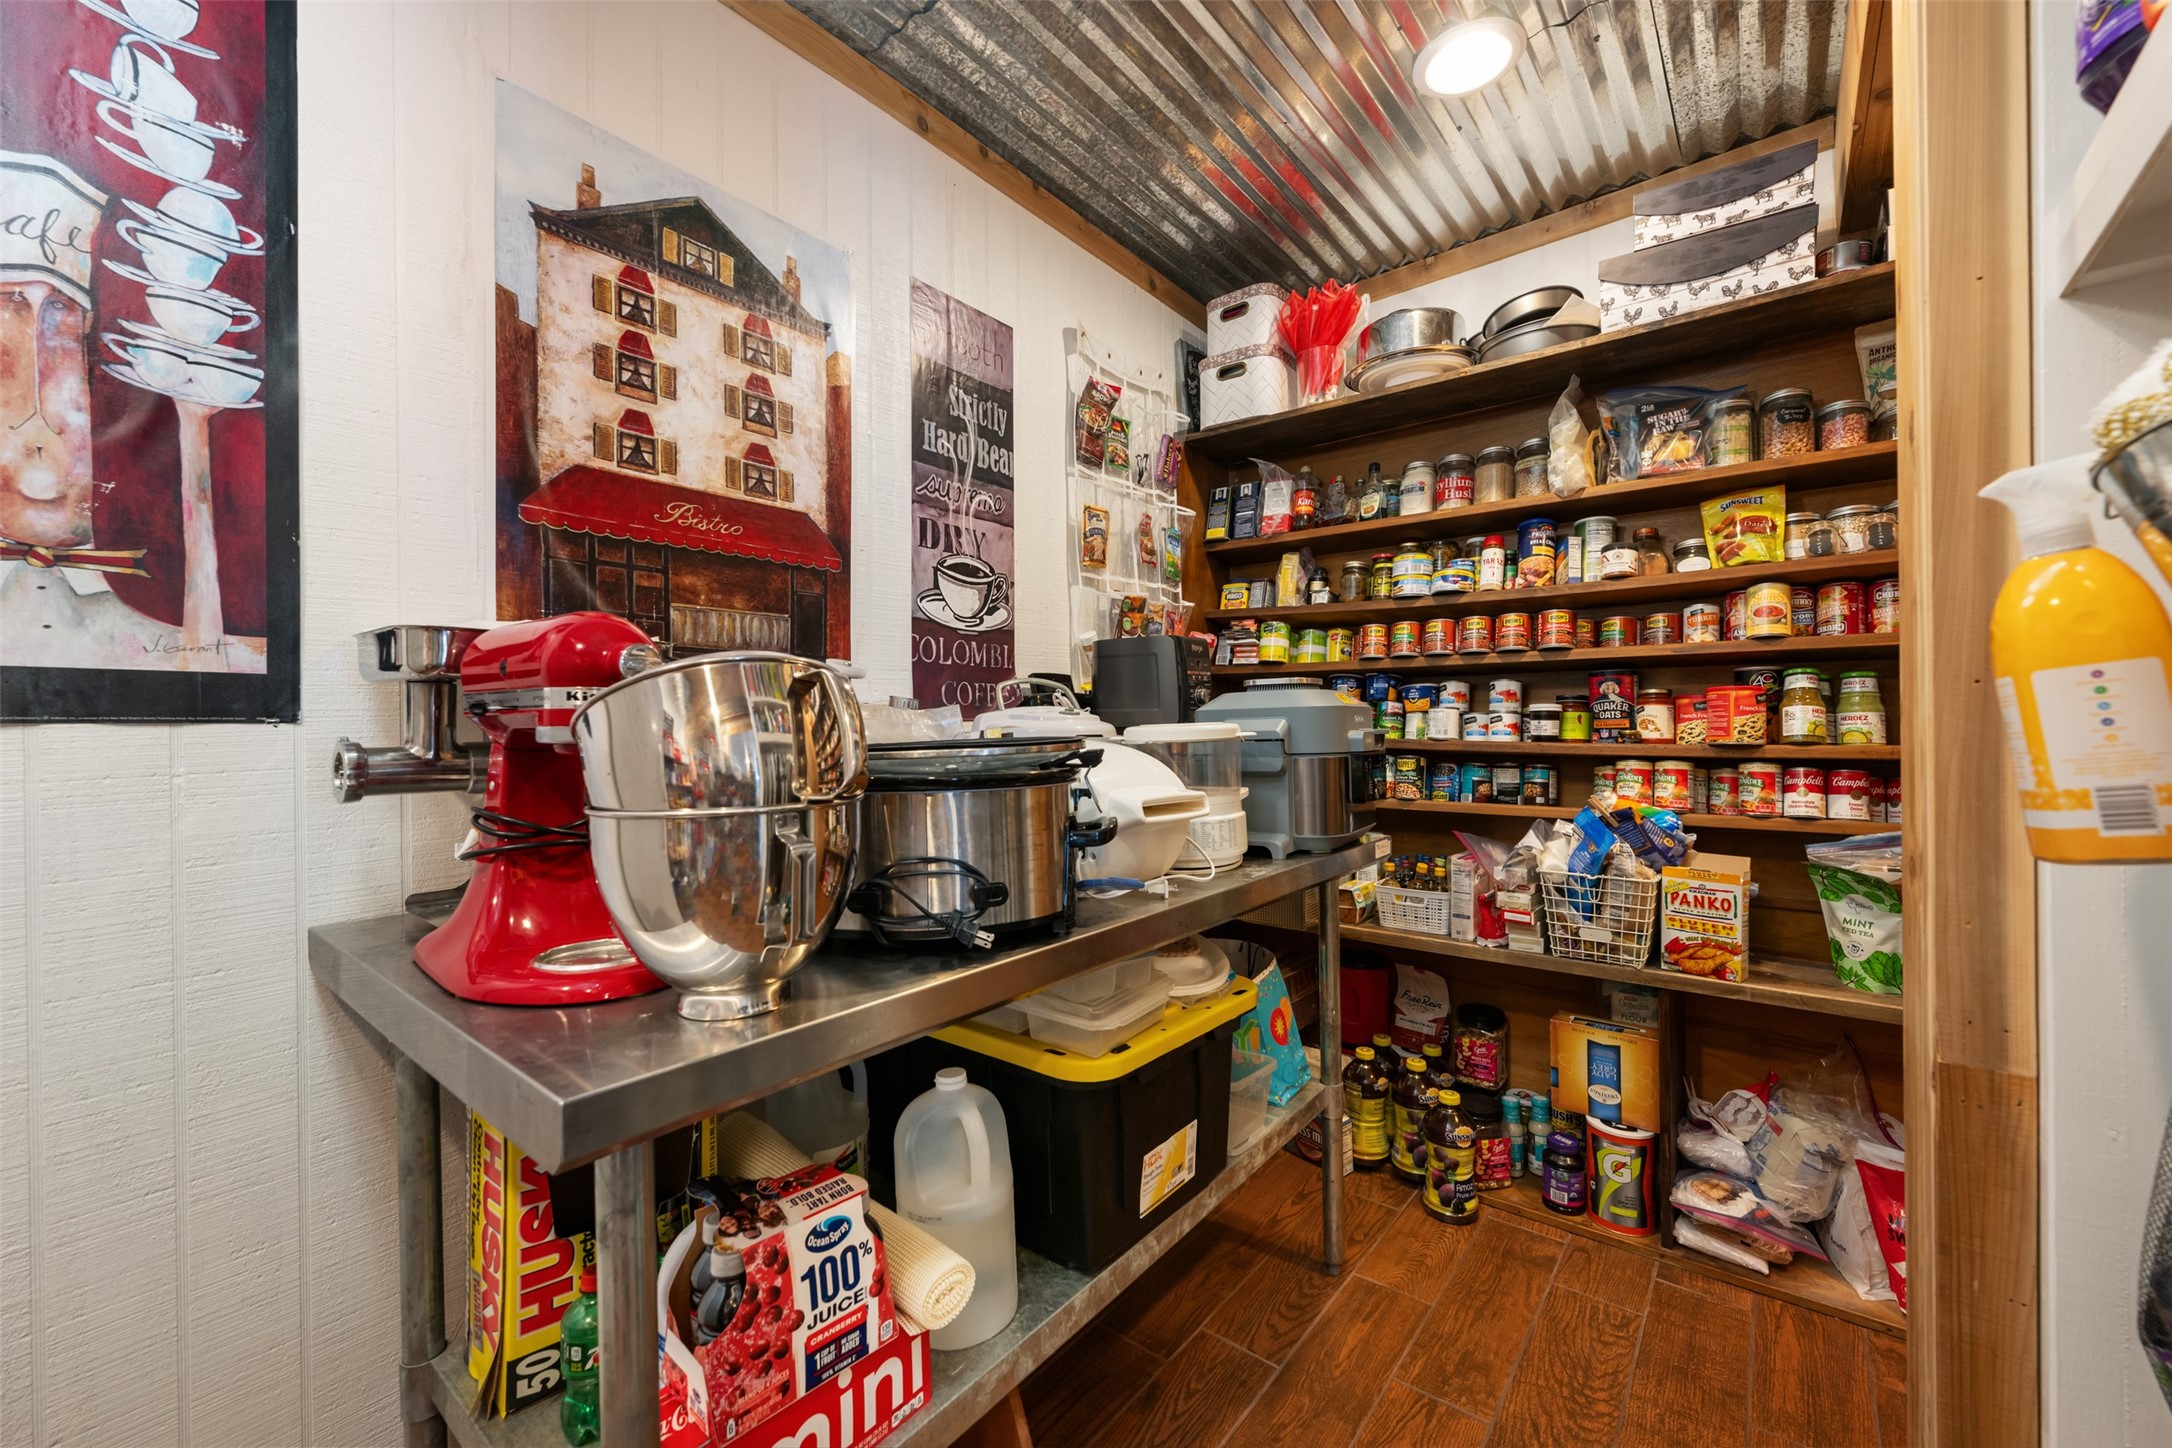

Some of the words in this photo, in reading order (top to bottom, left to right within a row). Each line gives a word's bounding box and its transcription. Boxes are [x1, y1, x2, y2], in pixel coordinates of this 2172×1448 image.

[0, 209, 92, 265] afe
[949, 383, 1007, 437] Strictly
[922, 418, 970, 464] Hard
[1444, 487, 1474, 500] Husk
[1720, 495, 1765, 513] SUNSWEET
[653, 501, 744, 536] Bistro
[1226, 592, 1243, 600] ARGO
[1688, 614, 1718, 624] TURKEY
[1593, 702, 1630, 713] QUAKER
[1599, 711, 1622, 719] OATS
[1670, 890, 1732, 912] PANKO
[1669, 916, 1734, 931] GLUTEN
[1842, 917, 1875, 929] MINT
[1858, 929, 1874, 939] TEA
[1400, 989, 1421, 1004] Free
[1421, 995, 1443, 1010] Rein
[1400, 1017, 1434, 1029] HOMESTEAD
[1620, 1013, 1648, 1024] FLOUR
[1592, 1062, 1617, 1073] GREY
[1592, 1070, 1617, 1081] LADY
[1590, 1088, 1619, 1099] TWININGS
[1143, 1149, 1164, 1171] HDX
[1603, 1153, 1633, 1184] G
[814, 1177, 847, 1196] RAISED
[828, 1184, 854, 1200] BORN
[786, 1191, 815, 1207] BOLD.
[802, 1196, 828, 1211] TART.
[482, 1130, 503, 1354] HUSKY
[807, 1235, 830, 1247] Ocean
[829, 1221, 850, 1240] Spray
[801, 1239, 873, 1312] 100%
[807, 1288, 864, 1330] JUICE
[811, 1311, 862, 1346] CRANBERRY
[841, 1337, 860, 1355] ADDED
[814, 1352, 821, 1371] 1
[821, 1350, 837, 1368] FRUIT
[515, 1347, 562, 1399] 50
[728, 1423, 734, 1435] 6
